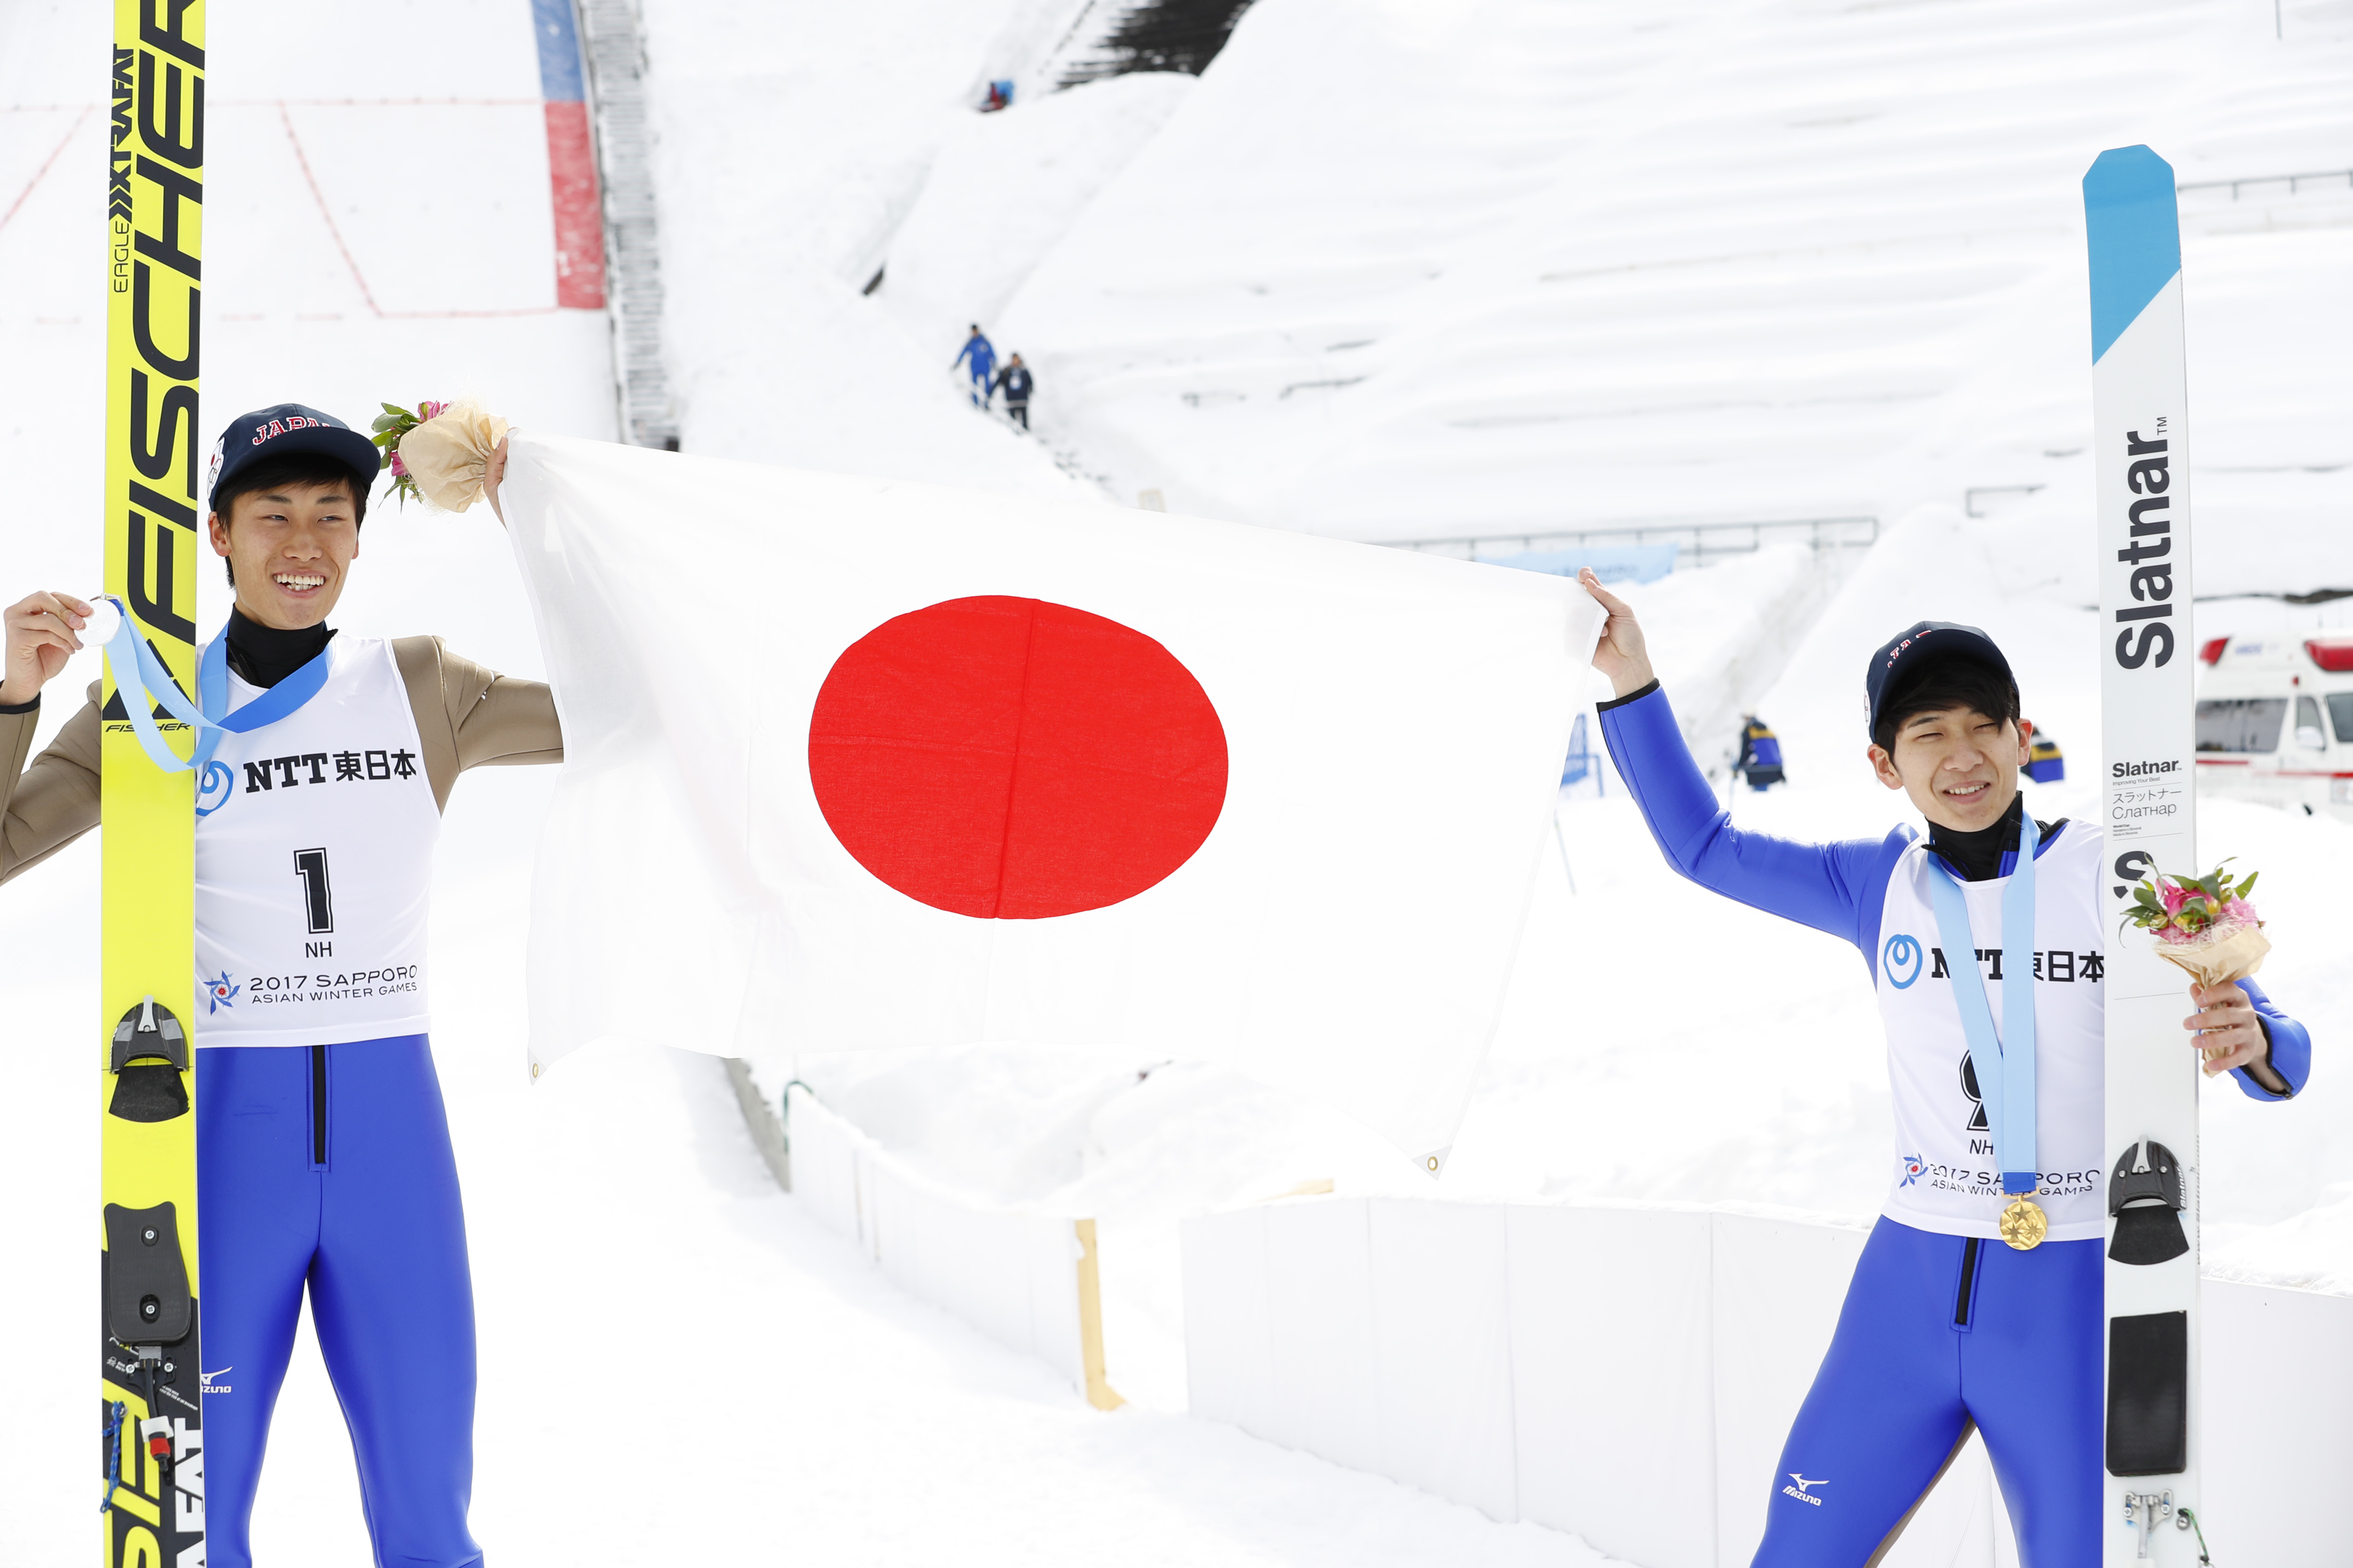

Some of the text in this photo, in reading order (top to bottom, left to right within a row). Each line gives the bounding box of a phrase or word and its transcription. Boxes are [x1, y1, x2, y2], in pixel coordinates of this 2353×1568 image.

[114, 221, 129, 293] EAGLE
[253, 417, 331, 445] JAPA
[2115, 431, 2175, 670] Slatnar
[105, 723, 193, 732] FISHER
[2112, 760, 2179, 778] Slatnar
[2113, 788, 2182, 804] スラットナー
[2112, 804, 2177, 820] Слатнар
[294, 847, 333, 934] 1
[306, 941, 332, 958] NH
[250, 965, 417, 991] 2017 SAPPORO
[251, 982, 417, 1004] ASIAN WINTER GAMES
[1969, 1139, 1994, 1155] NH
[1930, 1179, 1965, 1193] ASIAN
[2176, 1165, 2186, 1208] Slatnar
[1782, 1485, 1822, 1506] MIZUNO
